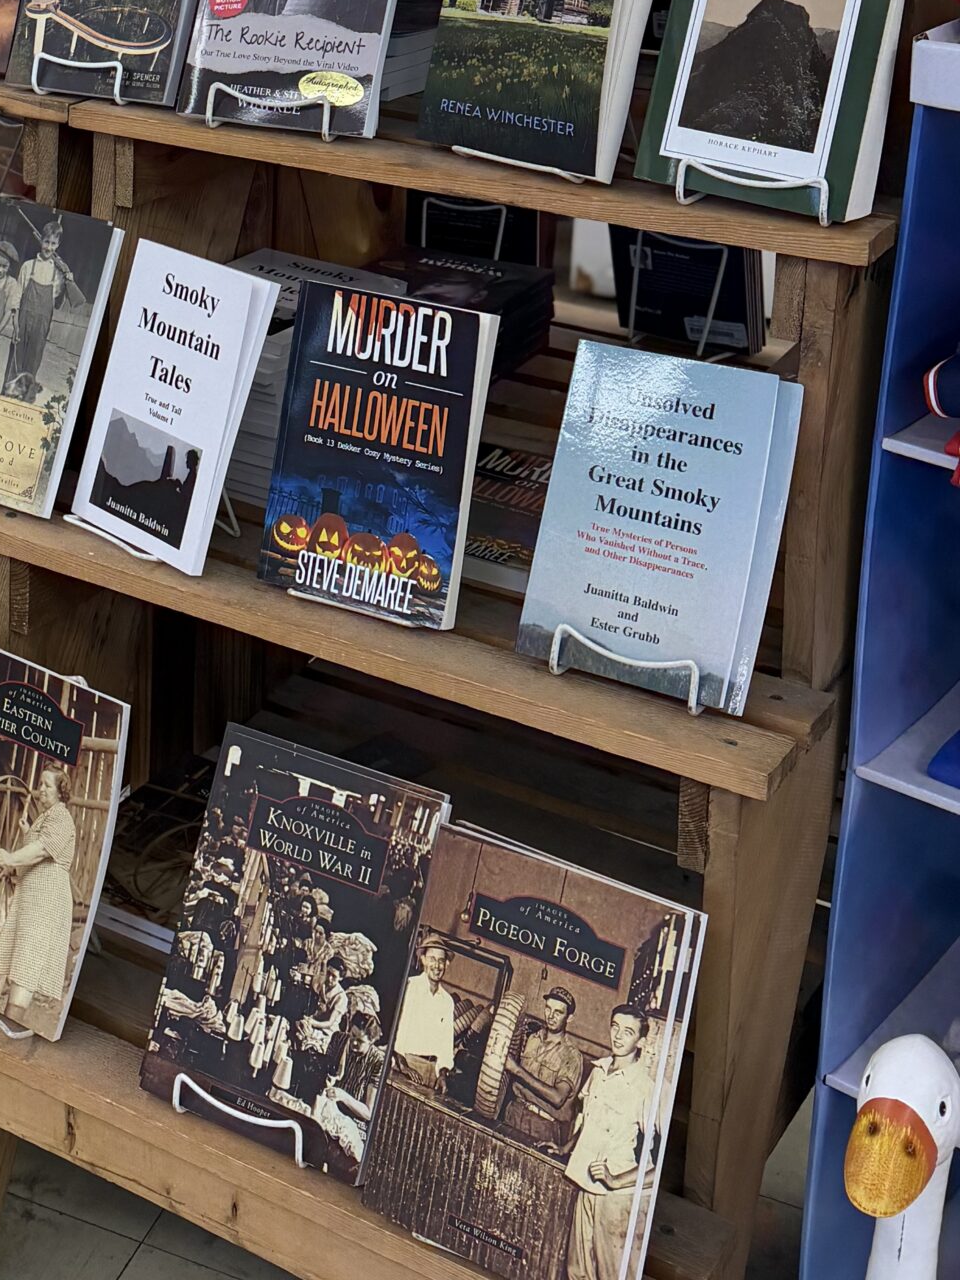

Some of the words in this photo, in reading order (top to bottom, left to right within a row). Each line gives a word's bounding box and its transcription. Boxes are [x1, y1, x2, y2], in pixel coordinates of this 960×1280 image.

[207, 24, 232, 42] The
[216, 50, 231, 58] True
[233, 52, 251, 60] Love
[252, 54, 271, 63] Story
[274, 56, 301, 66] Beyond
[317, 61, 334, 69] Viral
[337, 63, 358, 71] Video
[440, 98, 482, 120] RENEA
[486, 107, 575, 137] WINCHESTER
[162, 273, 220, 318] Smoky
[137, 307, 221, 360] Mountain
[327, 290, 453, 377] MURDER
[149, 356, 192, 394] Tales
[373, 371, 398, 389] on
[309, 378, 448, 457] HALLOWEEN
[304, 434, 324, 445] (Book
[327, 439, 335, 447] 13
[364, 447, 381, 459] Cozy
[383, 452, 412, 467] Mystery
[415, 459, 443, 474] Series)
[656, 452, 688, 473] the
[588, 465, 645, 492] Great
[651, 478, 720, 513] Smoky
[595, 494, 702, 535] Mountains
[591, 522, 610, 533] True
[612, 528, 652, 544] Mysteries
[665, 541, 697, 555] Persons
[295, 551, 342, 595] STEVE
[341, 563, 417, 615] DEMAREE
[584, 584, 630, 604] Juanitta
[633, 596, 678, 616] Baldwin
[590, 617, 620, 633] Ester
[623, 626, 660, 644] Grubb
[3, 698, 52, 731] EASTERN
[22, 725, 70, 757] COUNTY
[267, 807, 356, 854] KNOXVILLE
[360, 846, 372, 860] in
[260, 828, 312, 862] WORLD
[319, 850, 352, 878] WAR
[358, 866, 372, 885] II
[477, 908, 546, 950] PIGEON
[553, 937, 616, 978] FORGE
[454, 1219, 472, 1233] Veta
[472, 1225, 498, 1245] Wilson
[500, 1240, 518, 1255] King
